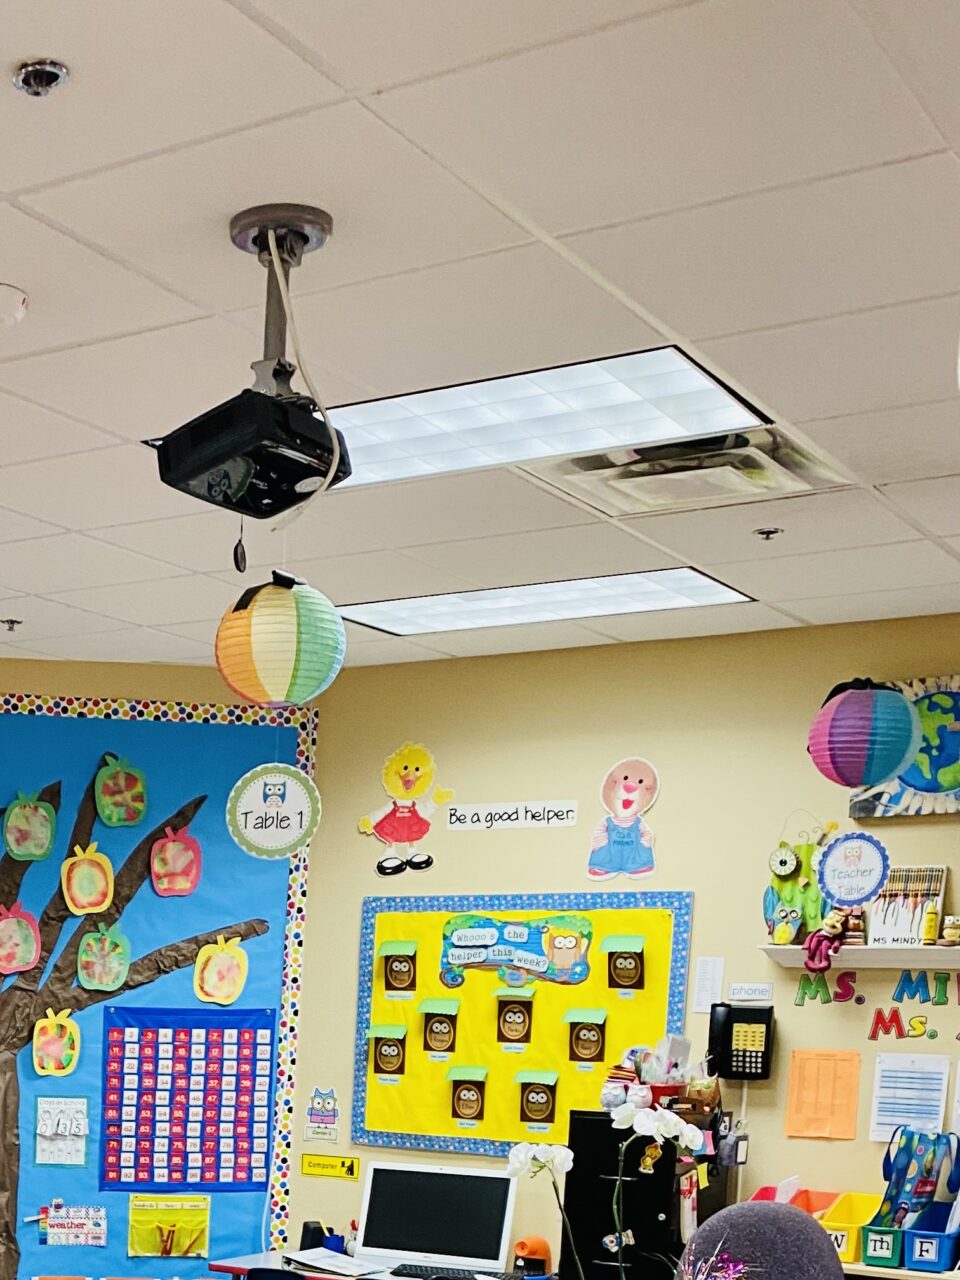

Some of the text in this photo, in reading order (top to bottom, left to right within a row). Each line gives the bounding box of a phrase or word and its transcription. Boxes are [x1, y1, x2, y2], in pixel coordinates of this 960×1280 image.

[241, 811, 303, 829] Table 1
[449, 808, 467, 824] Be
[471, 812, 482, 823] a
[486, 807, 519, 828] good
[832, 868, 875, 880] Teacher
[508, 930, 524, 939] the
[450, 948, 547, 966] helper this week?
[732, 986, 769, 996] phone
[892, 970, 960, 1005] MI
[868, 1007, 938, 1040] Ms.
[49, 1221, 86, 1230] weather
[831, 1235, 933, 1257] W Th F
